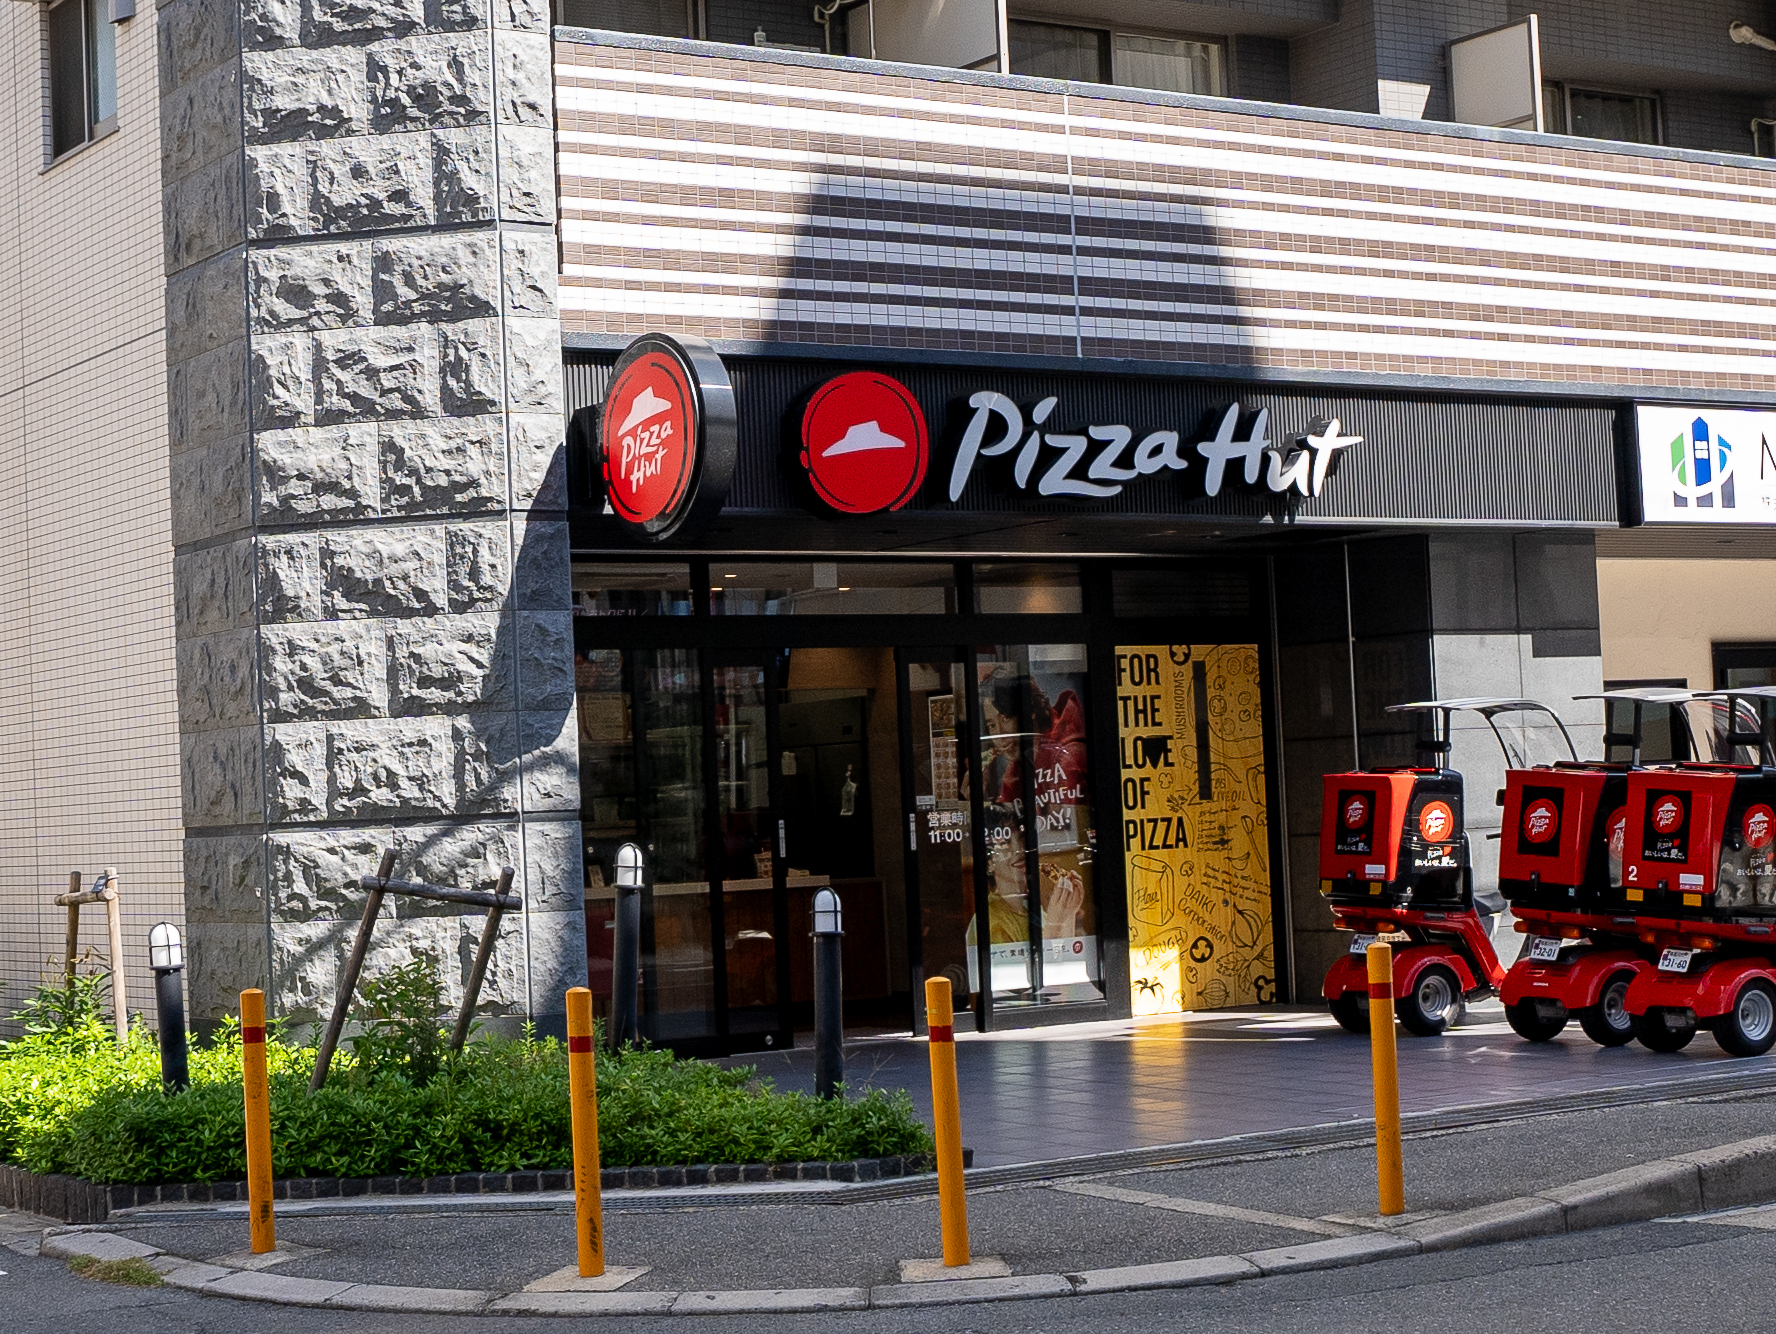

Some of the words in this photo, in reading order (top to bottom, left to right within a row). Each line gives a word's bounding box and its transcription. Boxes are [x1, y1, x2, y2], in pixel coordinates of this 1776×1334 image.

[621, 420, 674, 480] Pizza
[949, 390, 1189, 503] Pizza
[1197, 401, 1365, 498] Hut
[630, 445, 669, 494] Hut
[1116, 653, 1161, 687] FOR
[1118, 694, 1163, 728] THE
[1173, 670, 1187, 740] MUSHROOMS
[1123, 776, 1151, 811] OF
[928, 829, 963, 844] 11:00
[1124, 816, 1189, 852] PIZZA
[1628, 865, 1638, 881] 2
[1183, 882, 1217, 915] DAIKI
[1178, 897, 1228, 945] Corporation
[1142, 931, 1185, 965] DOUGH
